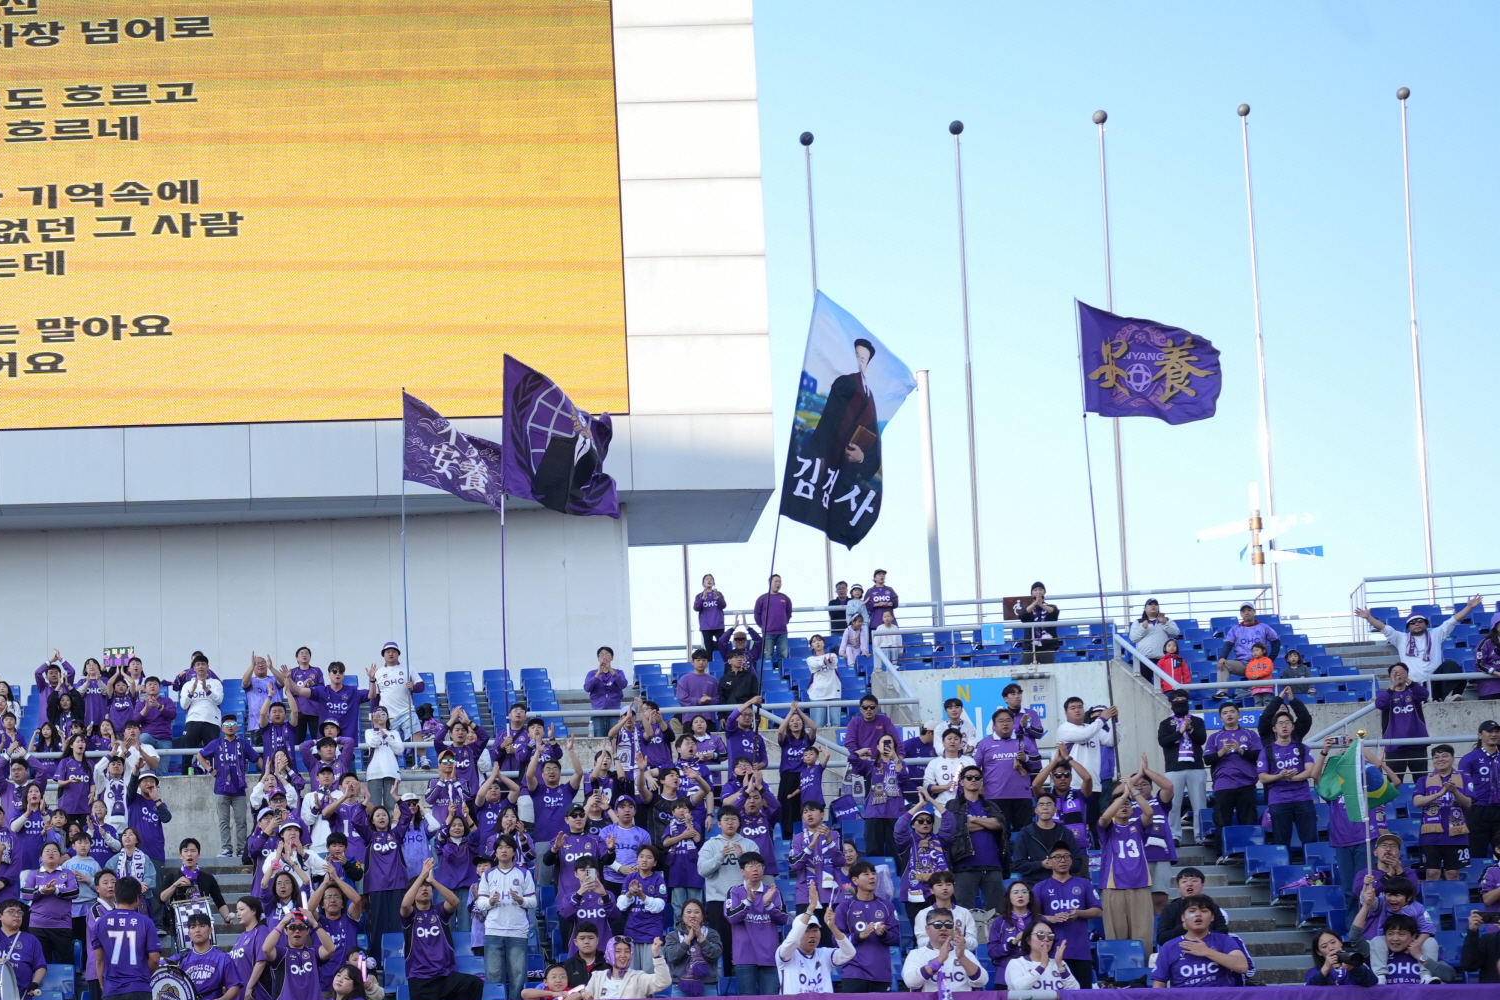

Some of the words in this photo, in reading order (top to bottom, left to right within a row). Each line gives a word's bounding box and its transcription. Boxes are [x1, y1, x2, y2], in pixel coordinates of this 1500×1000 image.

[80, 16, 214, 45] 넘어로
[62, 82, 198, 108] 흐르고
[4, 115, 139, 143] 흐르네
[18, 179, 199, 209] 기억속에
[93, 216, 136, 238] 그
[151, 211, 244, 238] 사람
[36, 314, 173, 343] 말아요
[1121, 351, 1166, 361] NYANG
[703, 600, 718, 608] OHC
[873, 595, 891, 603] OHC
[1240, 636, 1261, 646] OHC
[383, 677, 405, 686] OHC
[85, 686, 102, 695] OHC
[956, 684, 970, 702] N
[326, 702, 348, 711] OHC
[1393, 704, 1414, 714] OHC
[906, 730, 917, 740] N
[991, 751, 1019, 760] ANYAN
[1276, 757, 1299, 769] OHC
[68, 775, 90, 784] OHC
[835, 805, 860, 817] ANYAN
[25, 820, 46, 828] OHC
[743, 826, 767, 836] OHC
[373, 841, 398, 852] OHC
[1118, 839, 1141, 858] 13
[1457, 848, 1471, 861] 28
[1050, 898, 1081, 910] OHC
[576, 907, 607, 919] OHC
[106, 917, 138, 927] 채현우
[416, 924, 441, 938] OHC
[107, 930, 138, 966] 71
[289, 961, 314, 976] OHC
[1180, 961, 1220, 977] OHC
[1386, 961, 1422, 975] OHC
[799, 972, 822, 985] OHC
[1032, 979, 1065, 991] OHC
